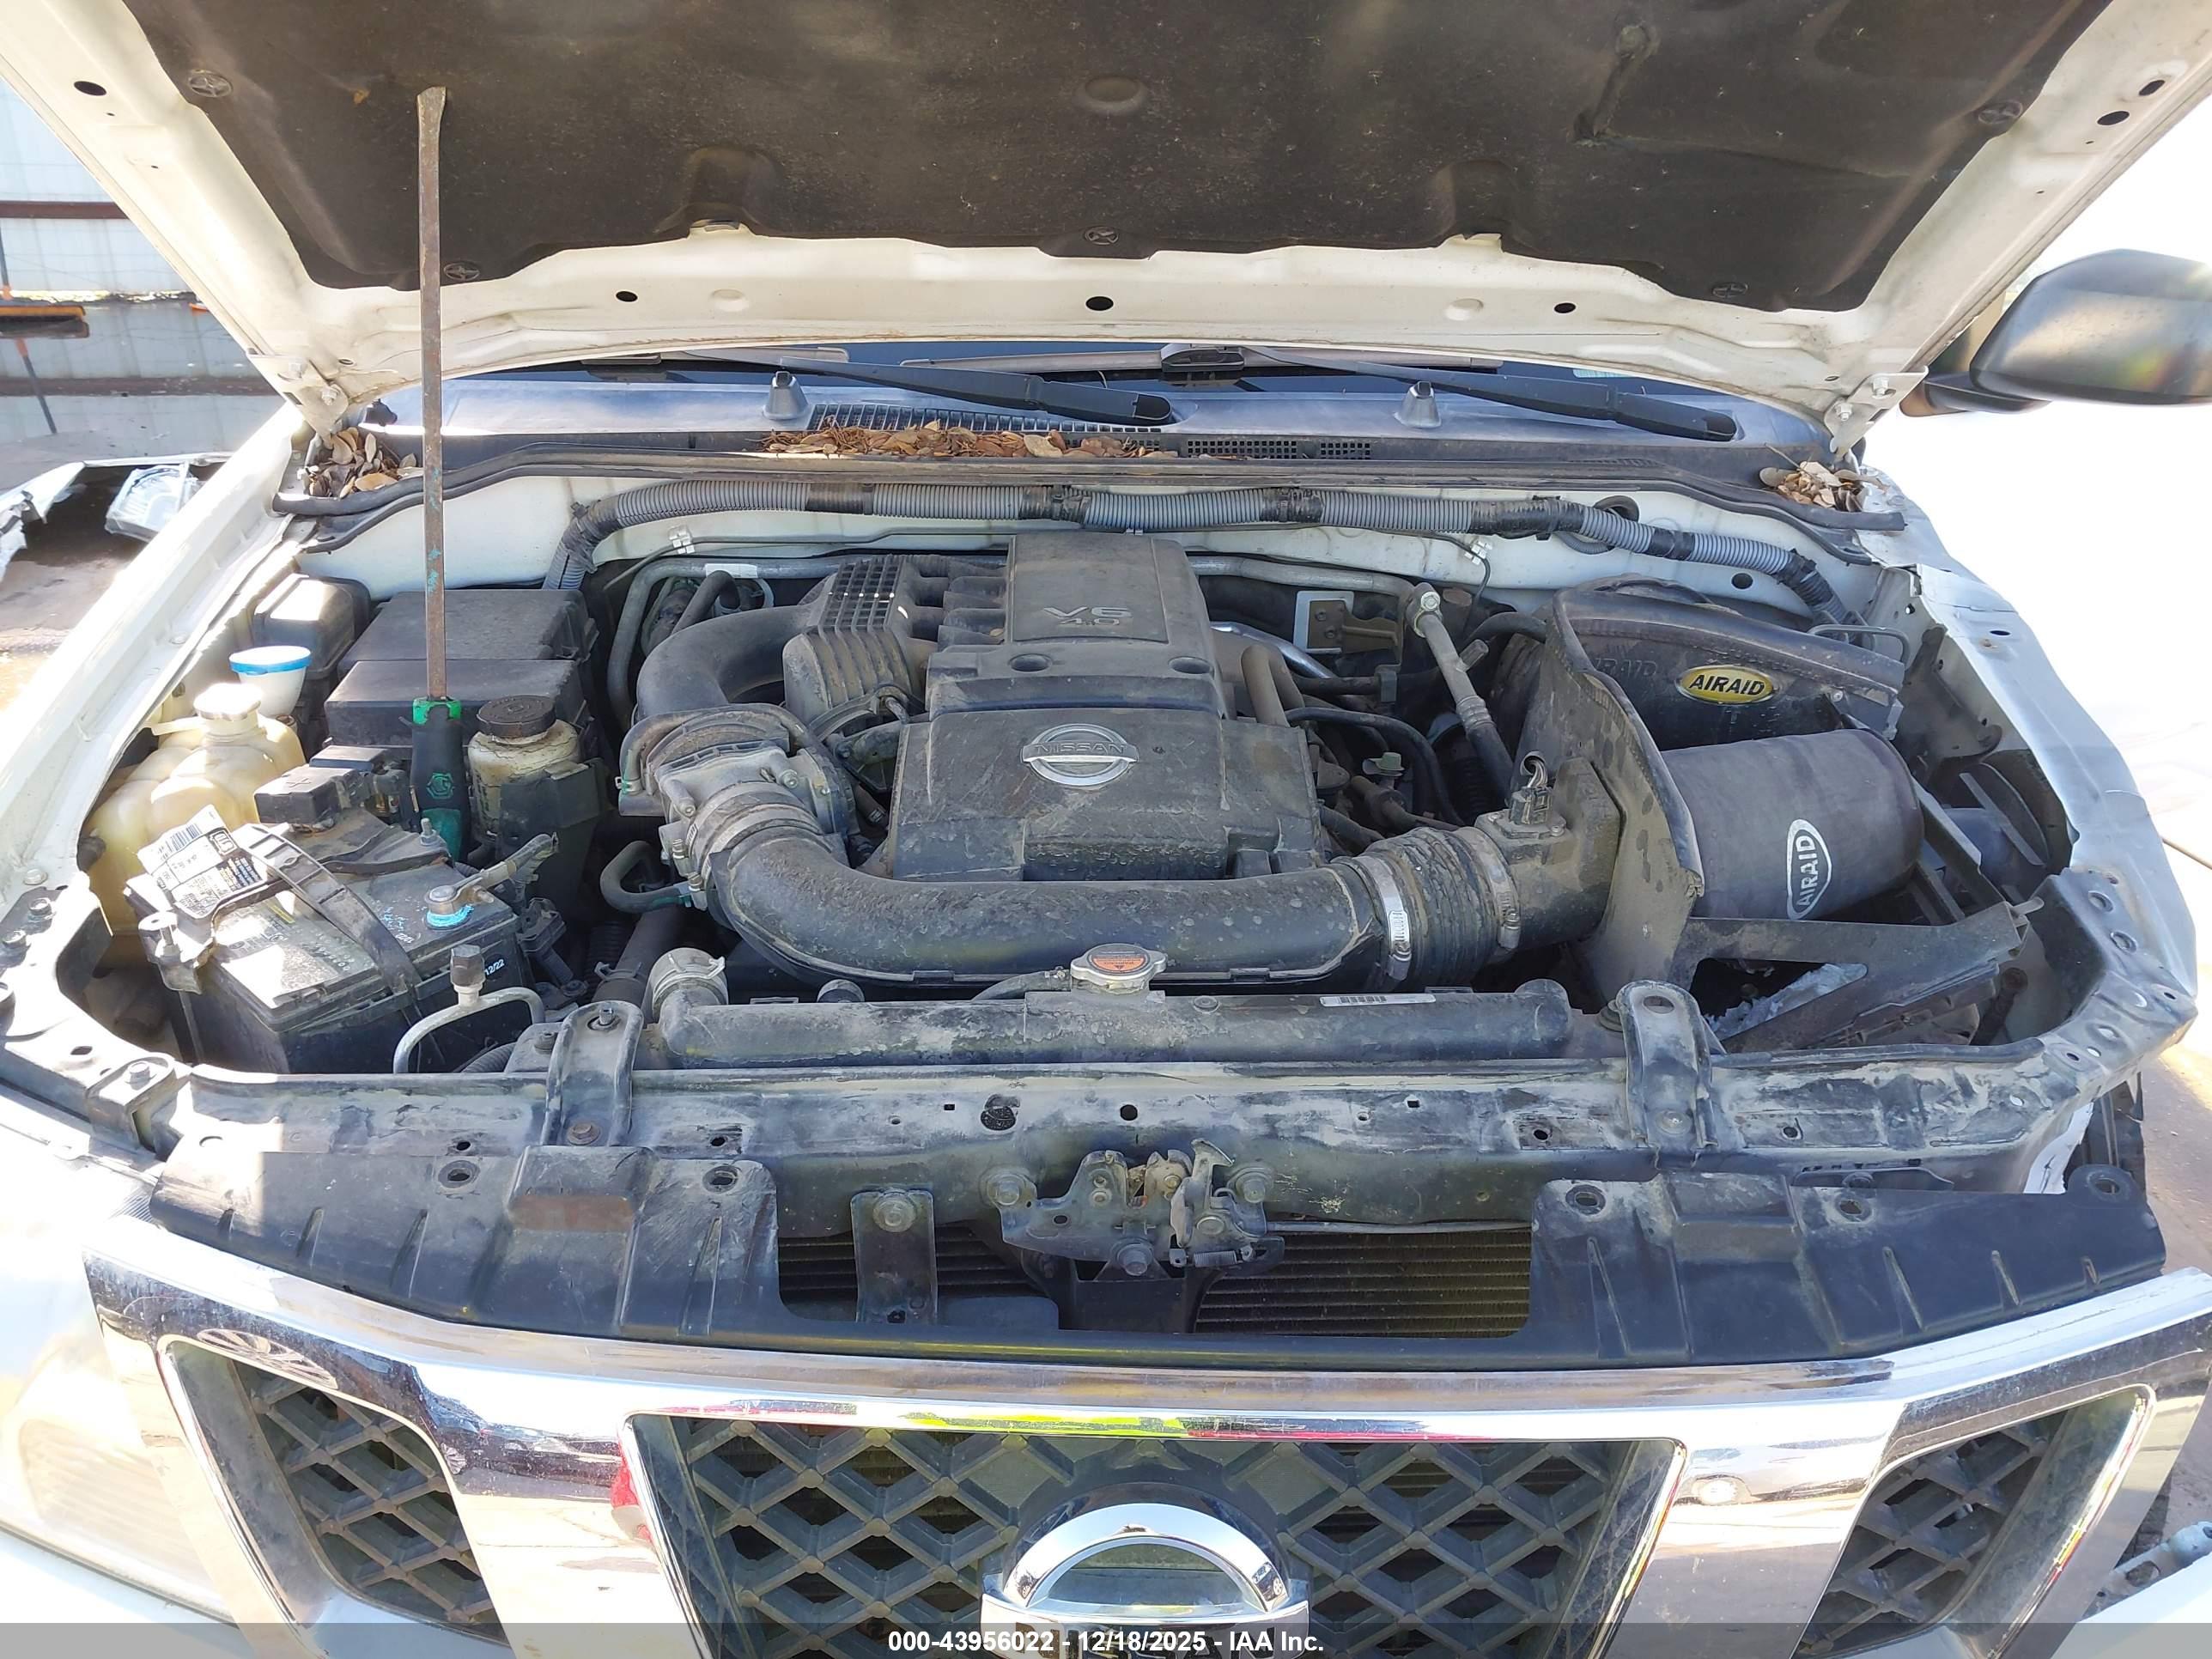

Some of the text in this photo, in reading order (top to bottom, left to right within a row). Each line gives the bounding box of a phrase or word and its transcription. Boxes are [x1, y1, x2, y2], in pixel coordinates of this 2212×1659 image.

[1043, 606, 1133, 618] V6
[1689, 675, 1765, 696] AIRAID
[1034, 742, 1126, 757] NISSAN
[1796, 836, 1819, 906] AIRAID
